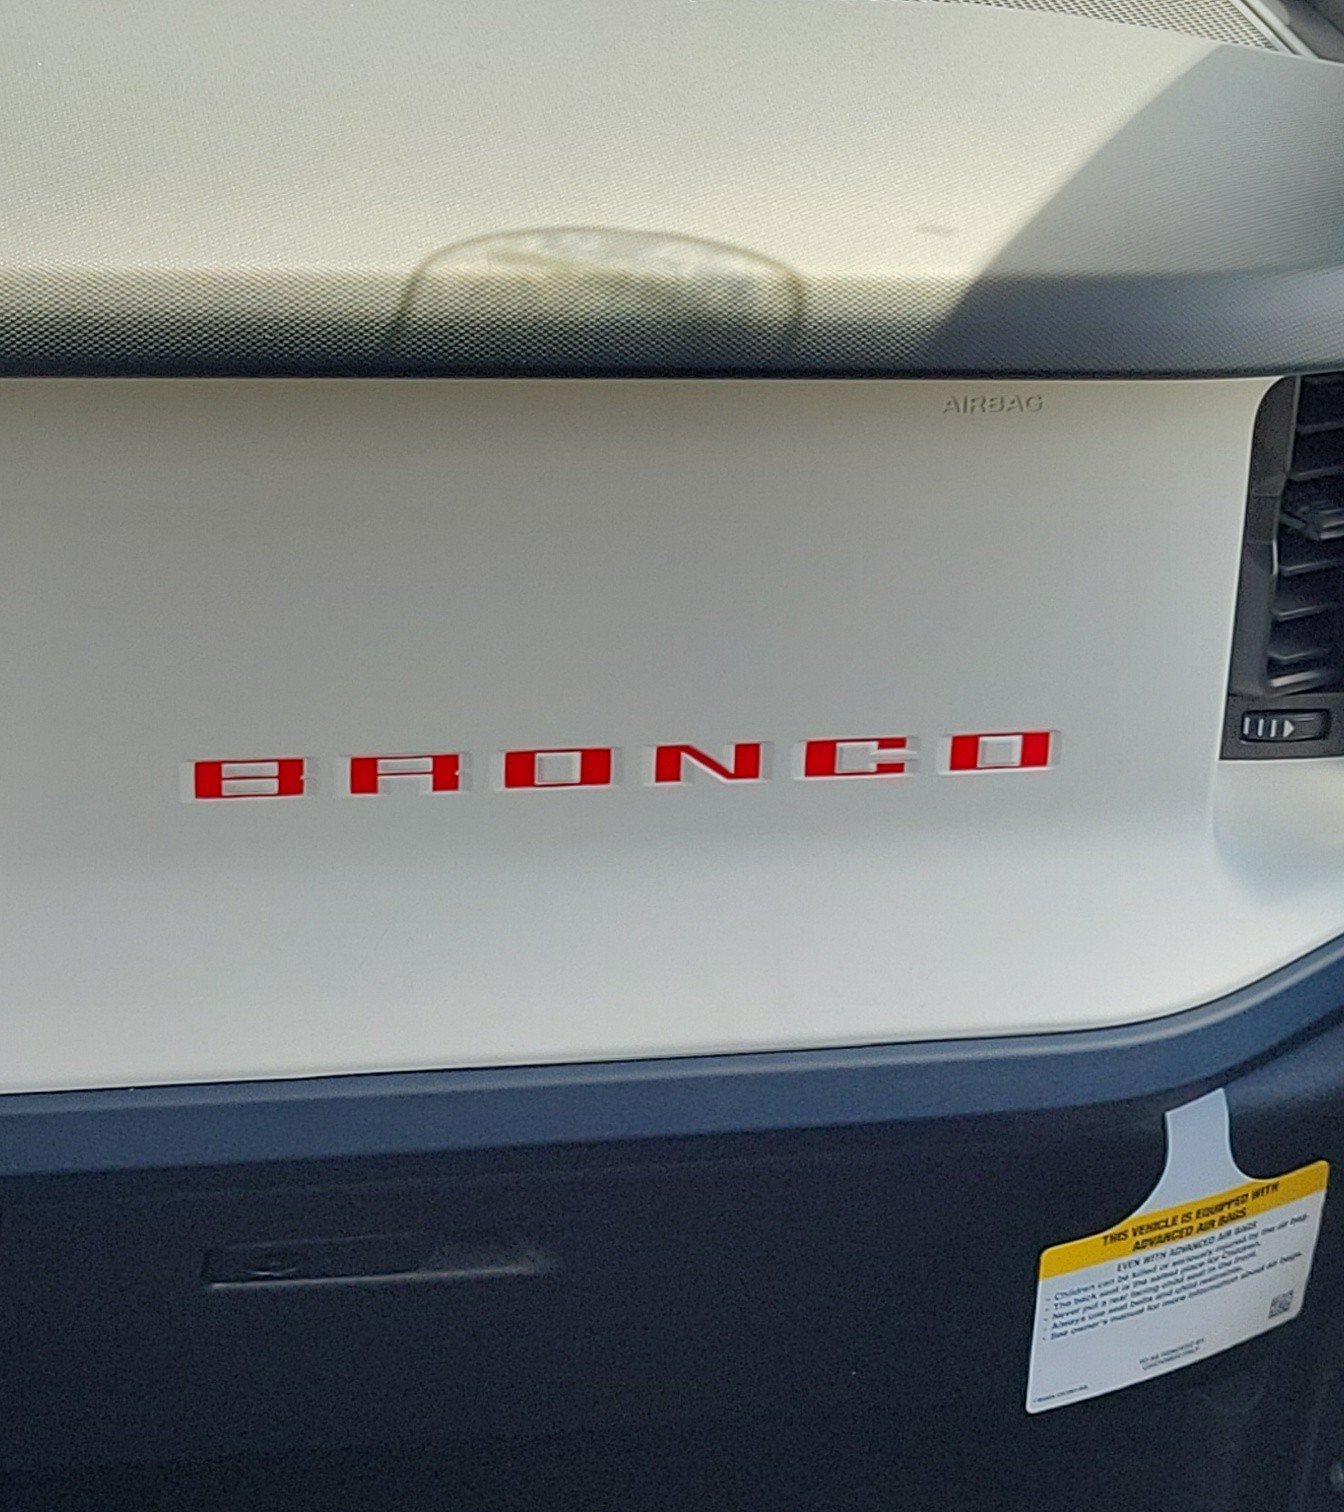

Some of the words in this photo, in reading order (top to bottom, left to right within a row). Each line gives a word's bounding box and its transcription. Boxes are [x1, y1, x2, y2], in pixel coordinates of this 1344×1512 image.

[942, 394, 1043, 414] AIRBAG
[190, 729, 1058, 801] BRONCO
[1102, 1230, 1128, 1245] THIS
[1131, 1215, 1178, 1237] VEHICLE
[1180, 1212, 1193, 1223] IS
[1195, 1193, 1249, 1219] EQUIPPED
[1251, 1181, 1280, 1199] WITH
[1132, 1226, 1194, 1252] ADVANCED
[1196, 1219, 1215, 1233] AIR
[1217, 1207, 1246, 1226] BAGS
